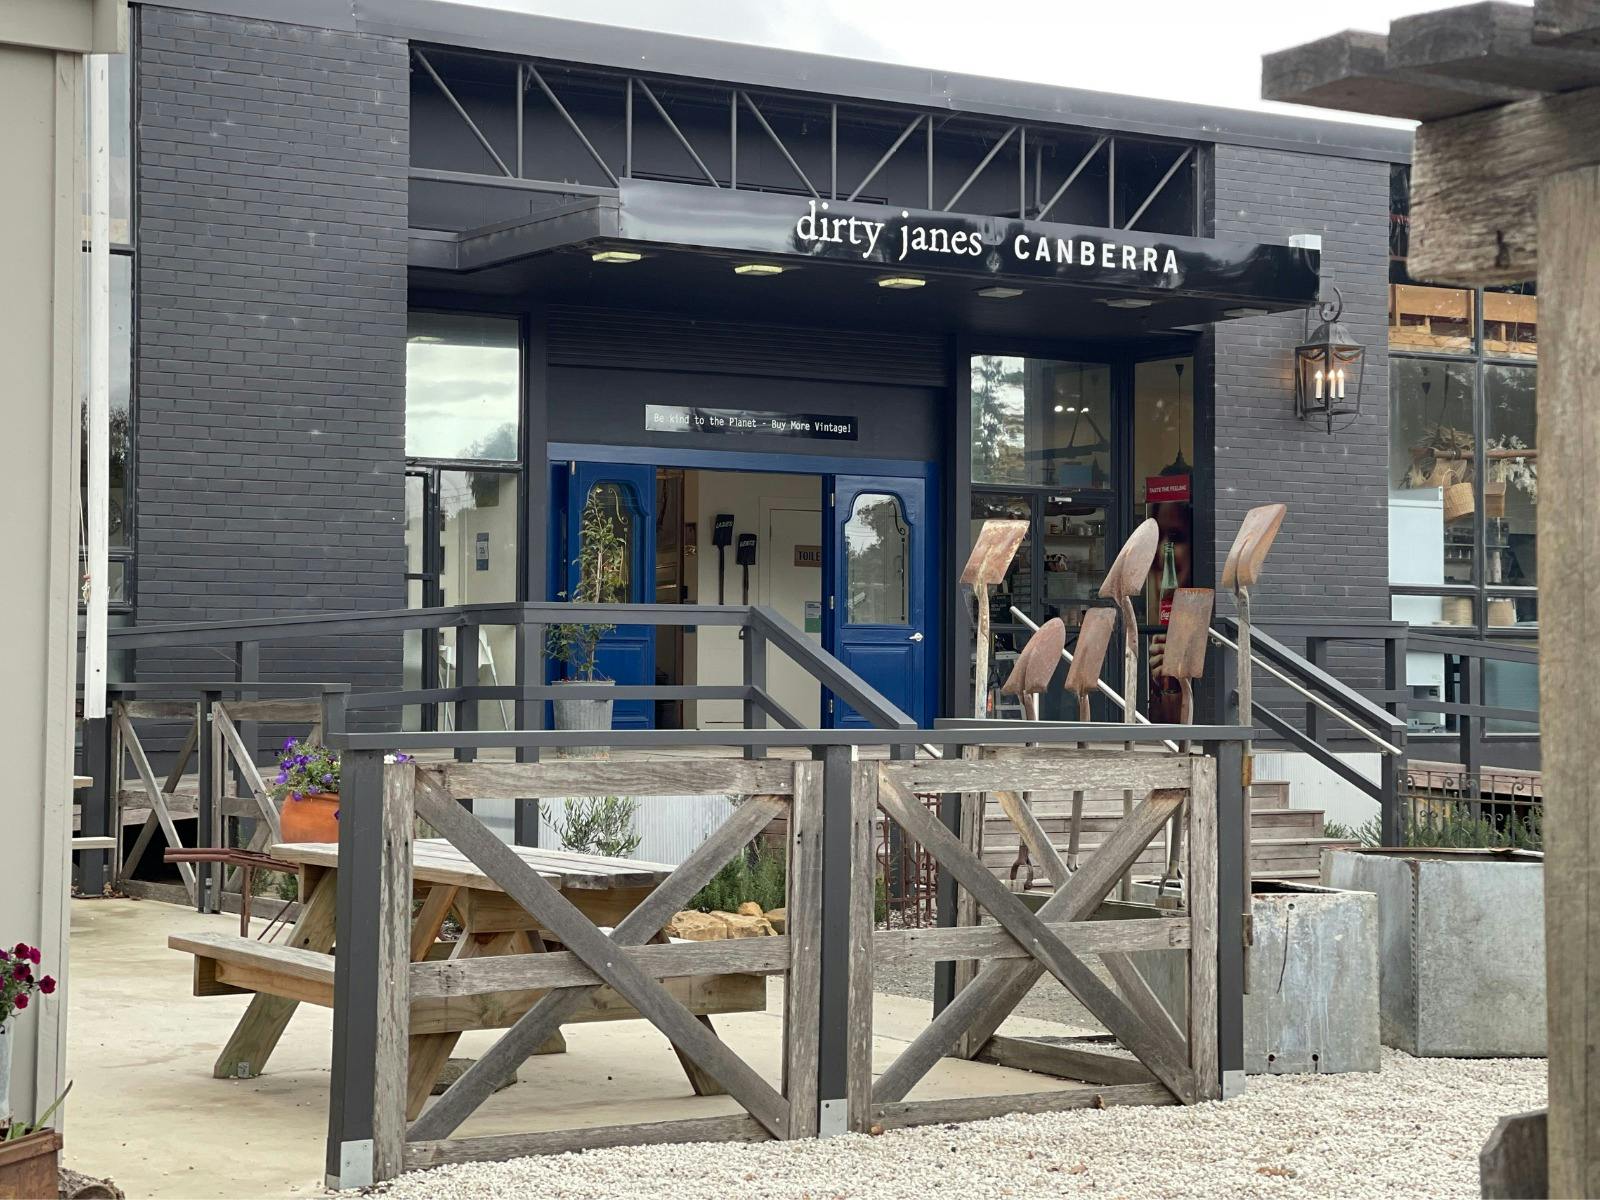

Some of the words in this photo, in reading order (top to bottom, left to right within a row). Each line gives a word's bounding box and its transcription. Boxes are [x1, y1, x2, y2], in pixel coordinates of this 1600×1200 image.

[796, 200, 885, 259] dirty
[898, 211, 983, 261] janes
[1014, 234, 1179, 274] CANBERRA
[654, 412, 664, 423] Be
[669, 414, 690, 425] kind
[694, 415, 704, 425] to
[710, 416, 724, 426] the
[729, 417, 757, 428] Planet
[771, 419, 786, 431] Buy
[790, 420, 810, 431] More
[814, 421, 851, 434] Vintage!
